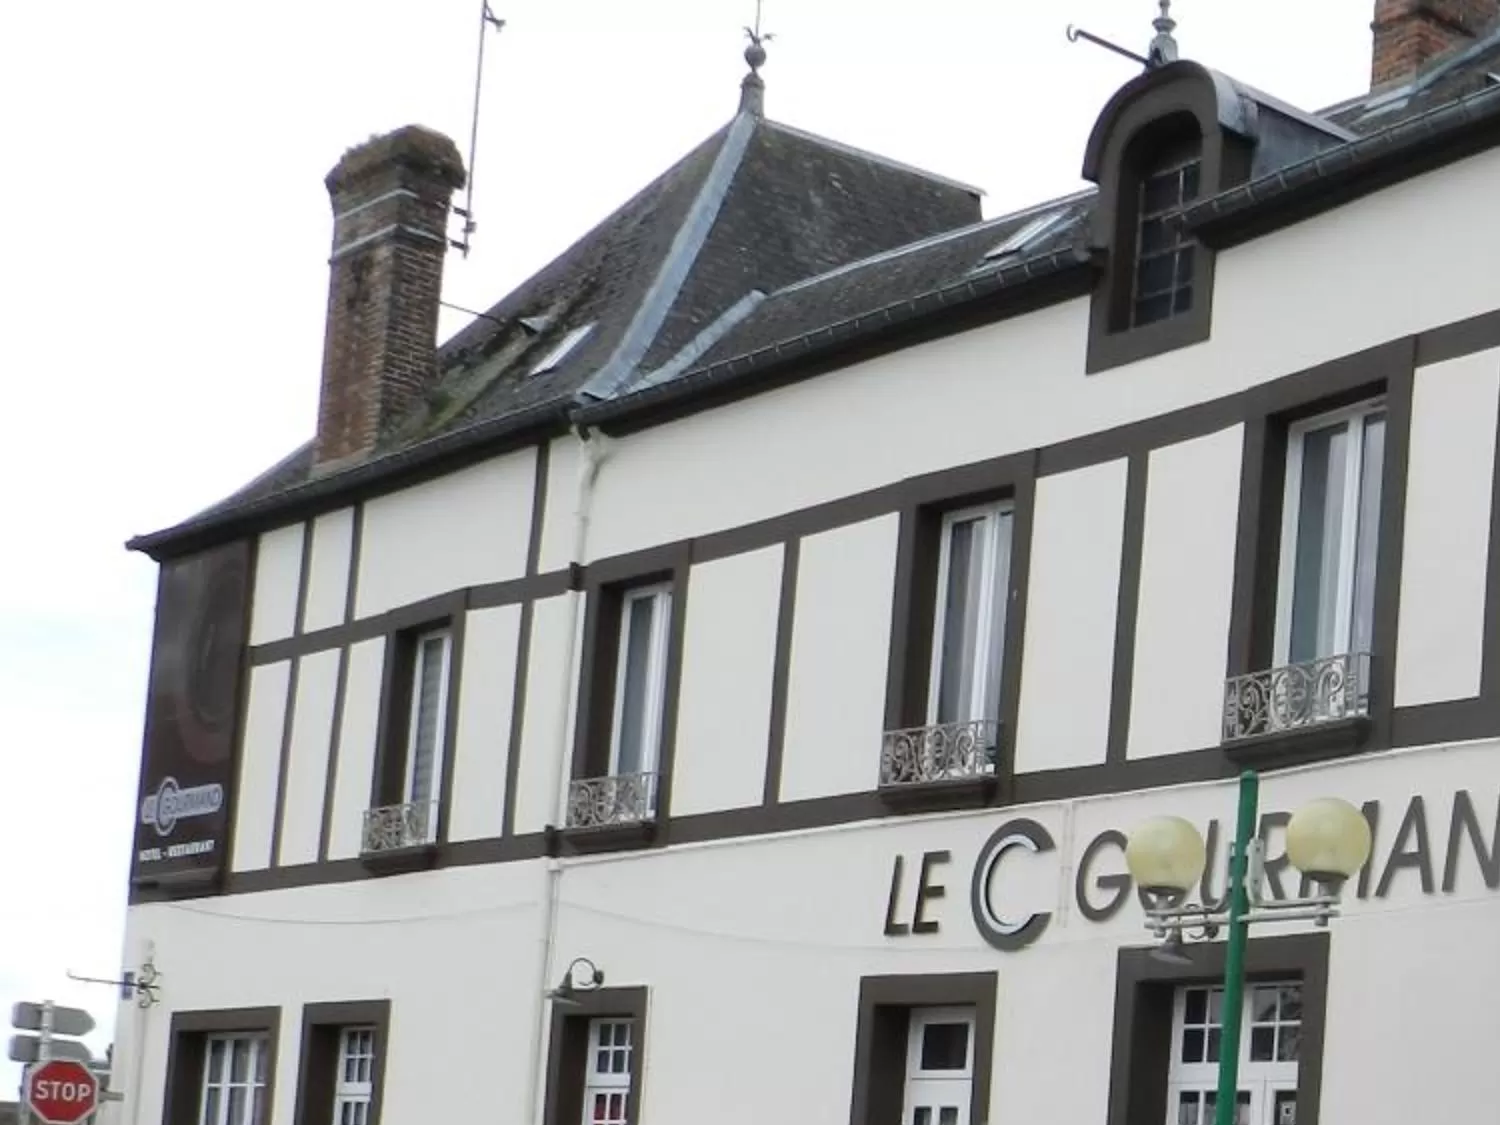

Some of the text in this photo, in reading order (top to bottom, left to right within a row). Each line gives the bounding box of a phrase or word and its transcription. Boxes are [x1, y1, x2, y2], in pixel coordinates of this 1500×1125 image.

[883, 850, 951, 936] LE
[970, 817, 1055, 951] C
[36, 1080, 91, 1102] STOP
